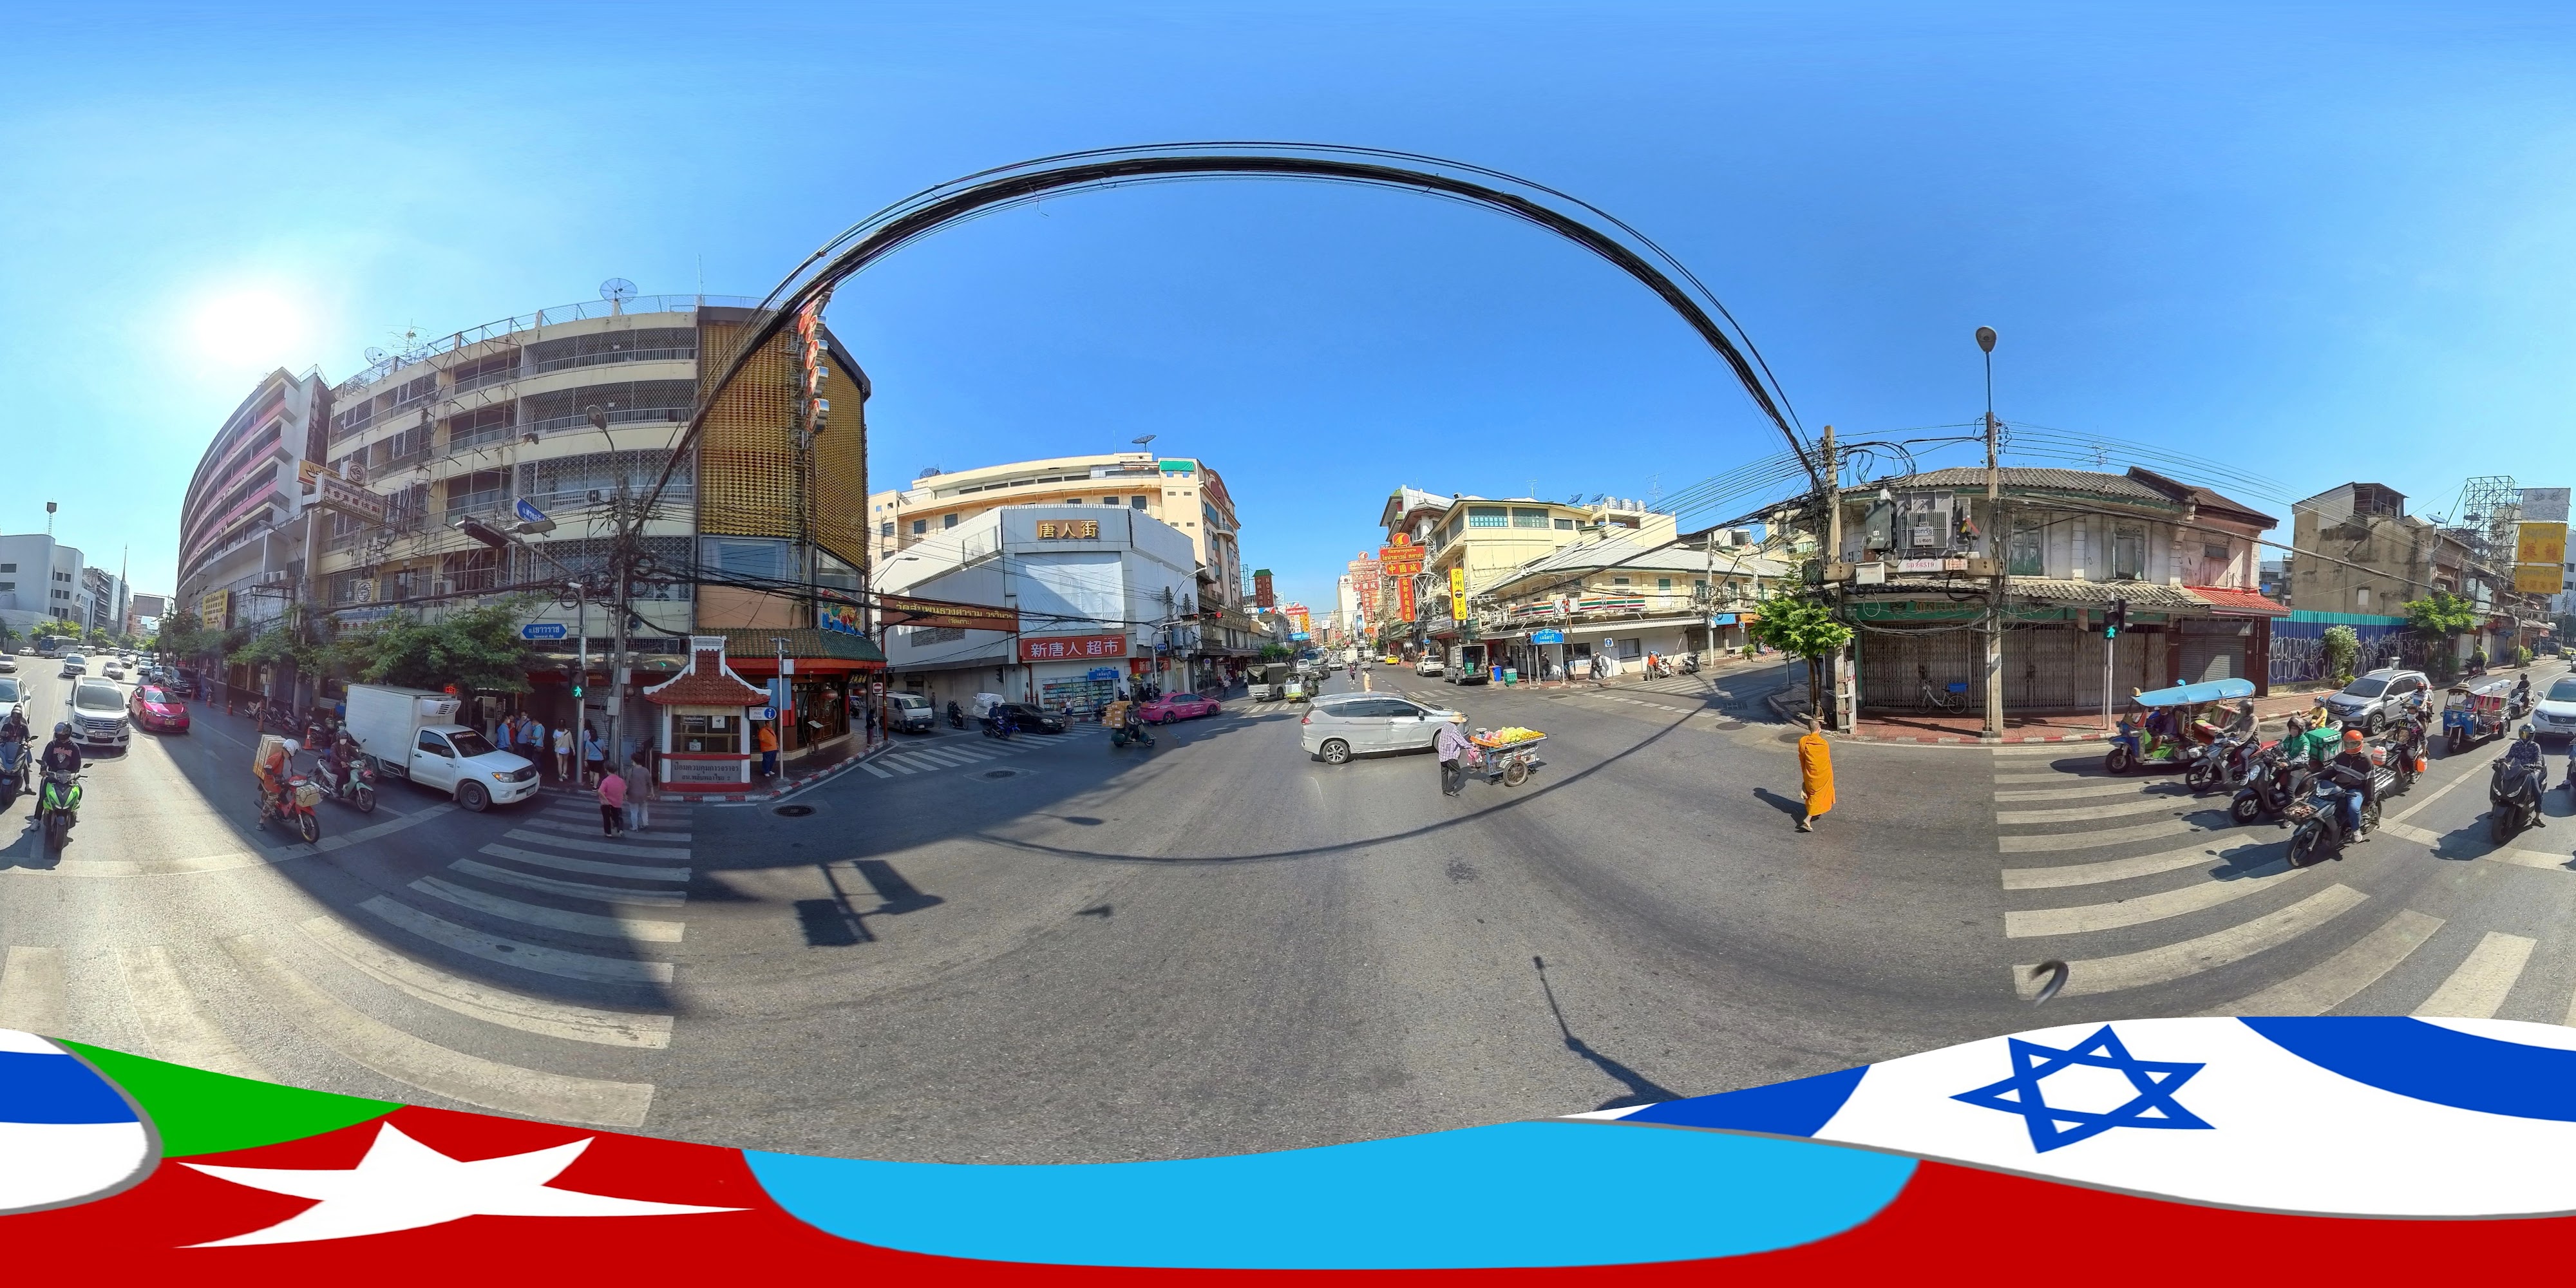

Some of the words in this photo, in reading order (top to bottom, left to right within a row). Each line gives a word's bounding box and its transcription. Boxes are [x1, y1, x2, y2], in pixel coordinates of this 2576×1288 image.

[1039, 520, 1097, 538] 唐人街
[1388, 564, 1419, 574] 中國城
[1453, 571, 1462, 588] 貴州
[985, 611, 1013, 620] วรวิหาร
[1457, 600, 1464, 618] 茅台
[1031, 639, 1119, 658] 新唐人超市
[1139, 660, 1168, 672] 新唐市
[674, 762, 739, 773] ป้อมควบคุมการจราจร
